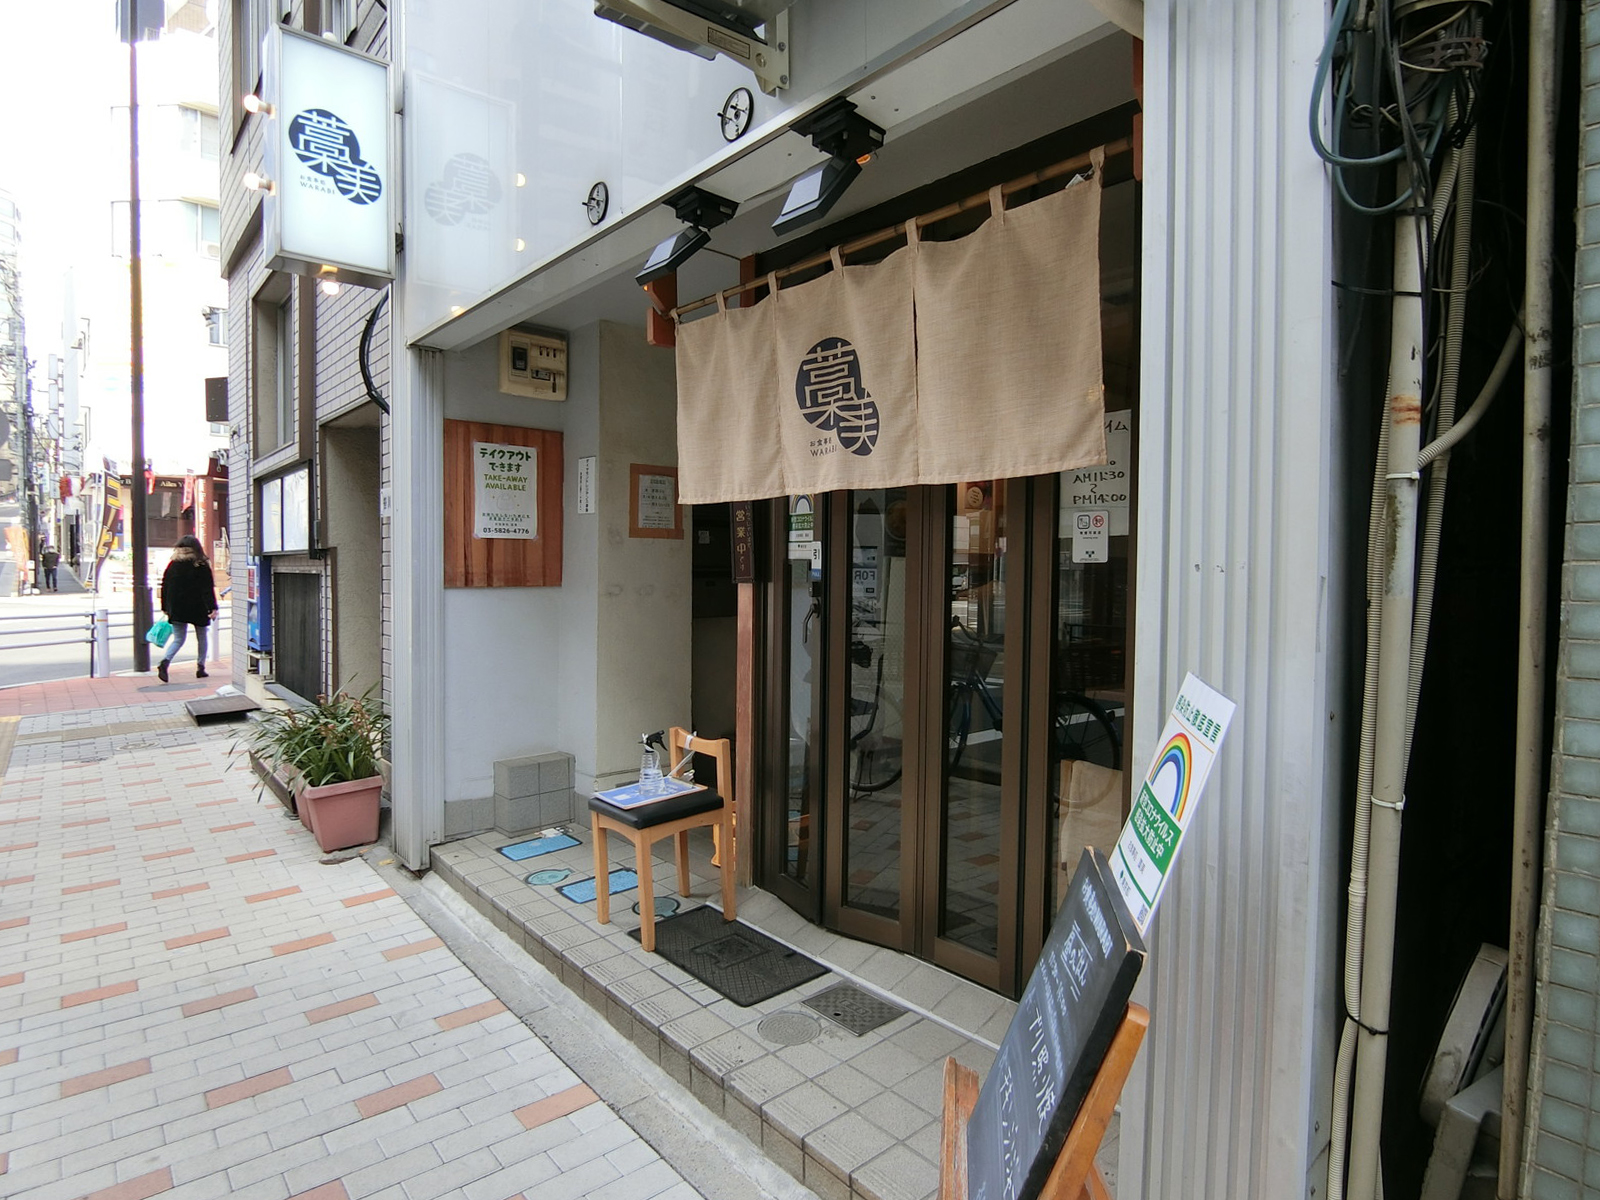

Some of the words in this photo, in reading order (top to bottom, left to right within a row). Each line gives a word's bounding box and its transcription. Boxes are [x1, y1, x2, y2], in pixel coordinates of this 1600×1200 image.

[299, 181, 336, 195] WARABI
[479, 447, 532, 462] テイクアウト
[488, 462, 523, 473] できます
[483, 474, 528, 483] TAKE-AWAY
[485, 482, 527, 491] AVAILABLE
[482, 527, 530, 535] 03-5826-4776
[1139, 789, 1175, 847] 新型コロナウイルス
[1133, 807, 1165, 859] 感染拡大防止中
